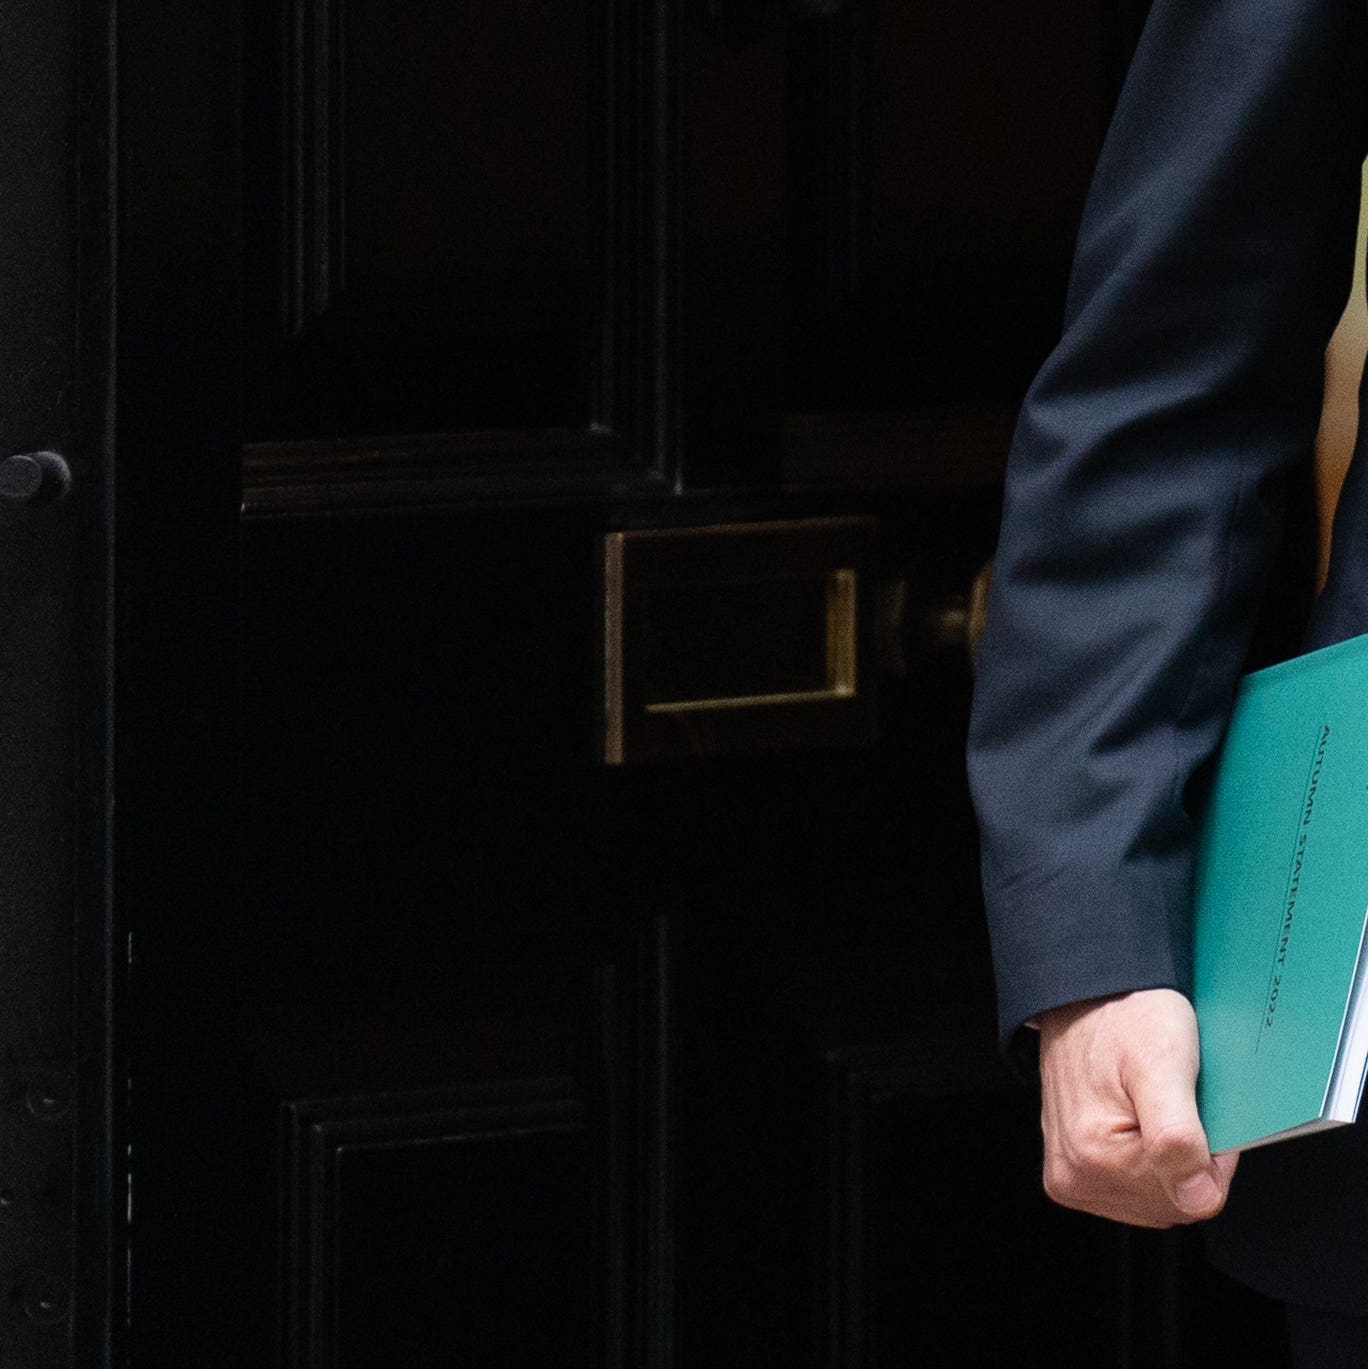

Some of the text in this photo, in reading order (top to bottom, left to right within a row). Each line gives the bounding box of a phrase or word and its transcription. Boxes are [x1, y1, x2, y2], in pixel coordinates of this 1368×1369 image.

[1264, 724, 1331, 1029] AUTUMN STATEMENT 2022
